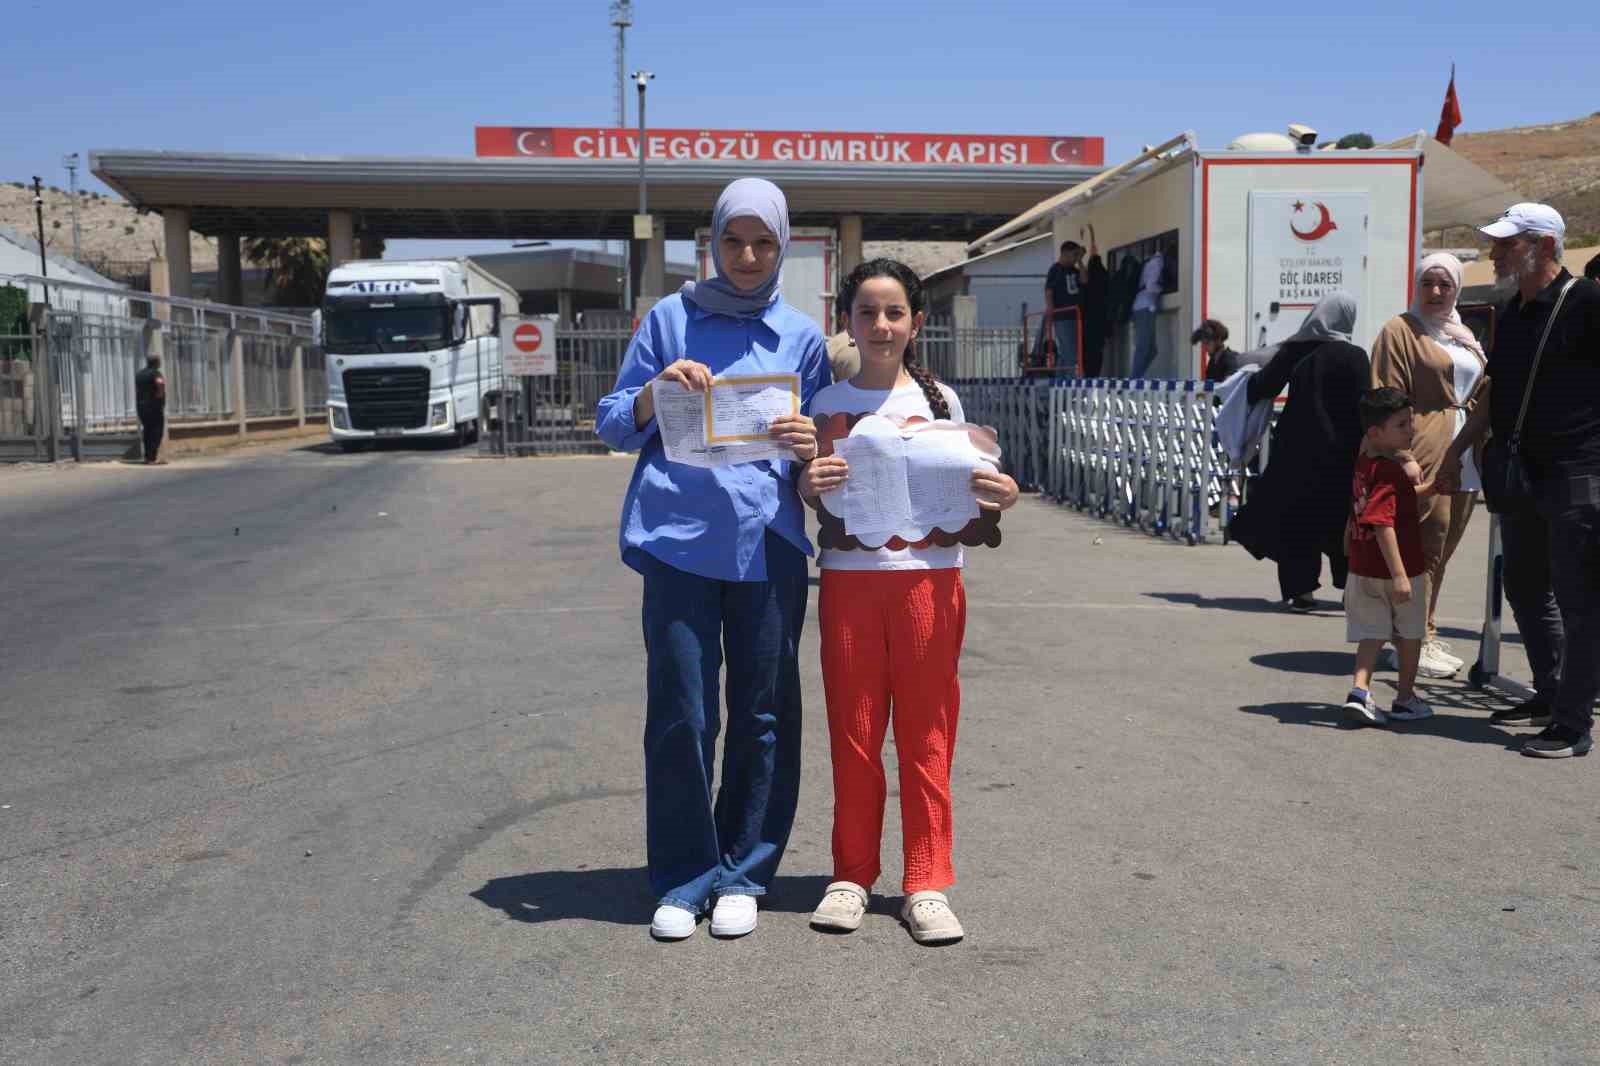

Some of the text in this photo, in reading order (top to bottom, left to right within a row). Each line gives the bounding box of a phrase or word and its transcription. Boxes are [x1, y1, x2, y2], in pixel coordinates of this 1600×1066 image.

[574, 130, 1028, 164] CİLVEGÖZÜ GÜMRÜK KAPISI
[1280, 269, 1343, 287] GÖÇ İDARESİ
